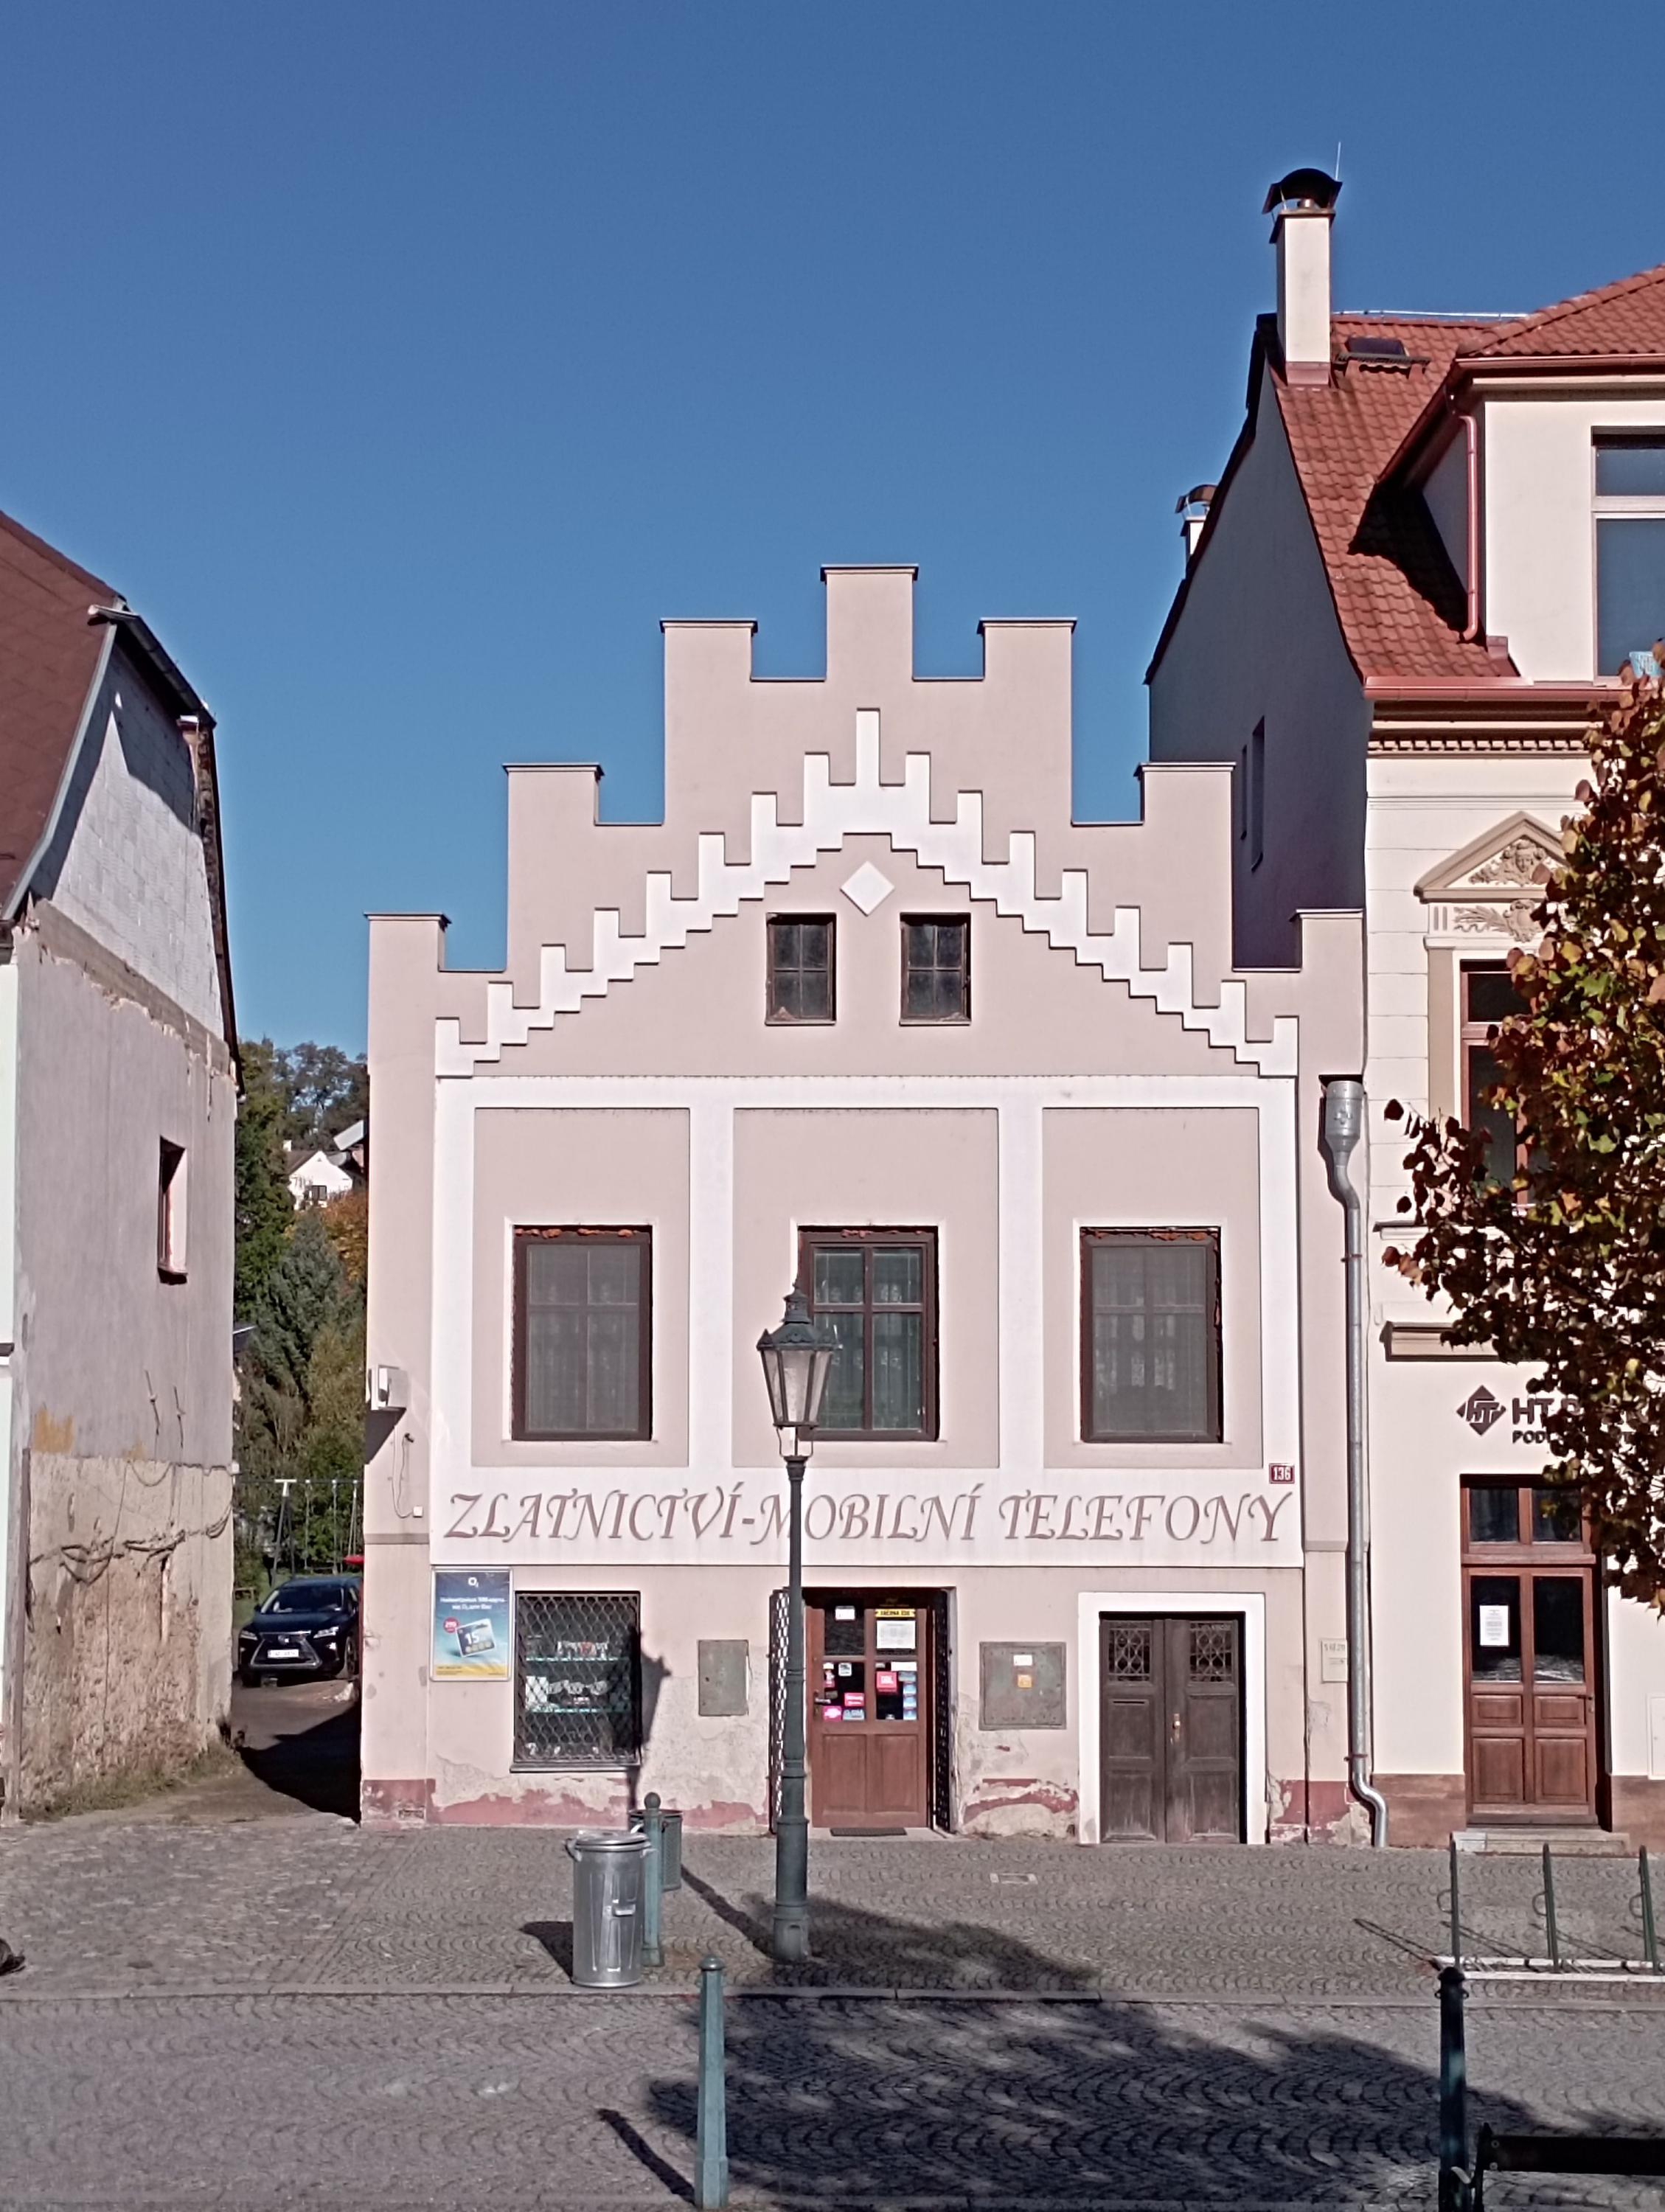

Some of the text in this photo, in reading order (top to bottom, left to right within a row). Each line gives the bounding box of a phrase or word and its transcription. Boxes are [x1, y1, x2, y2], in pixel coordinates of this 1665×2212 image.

[1273, 1467, 1291, 1481] 136
[998, 1489, 1293, 1545] TELEFONY
[465, 1630, 480, 1645] 15
